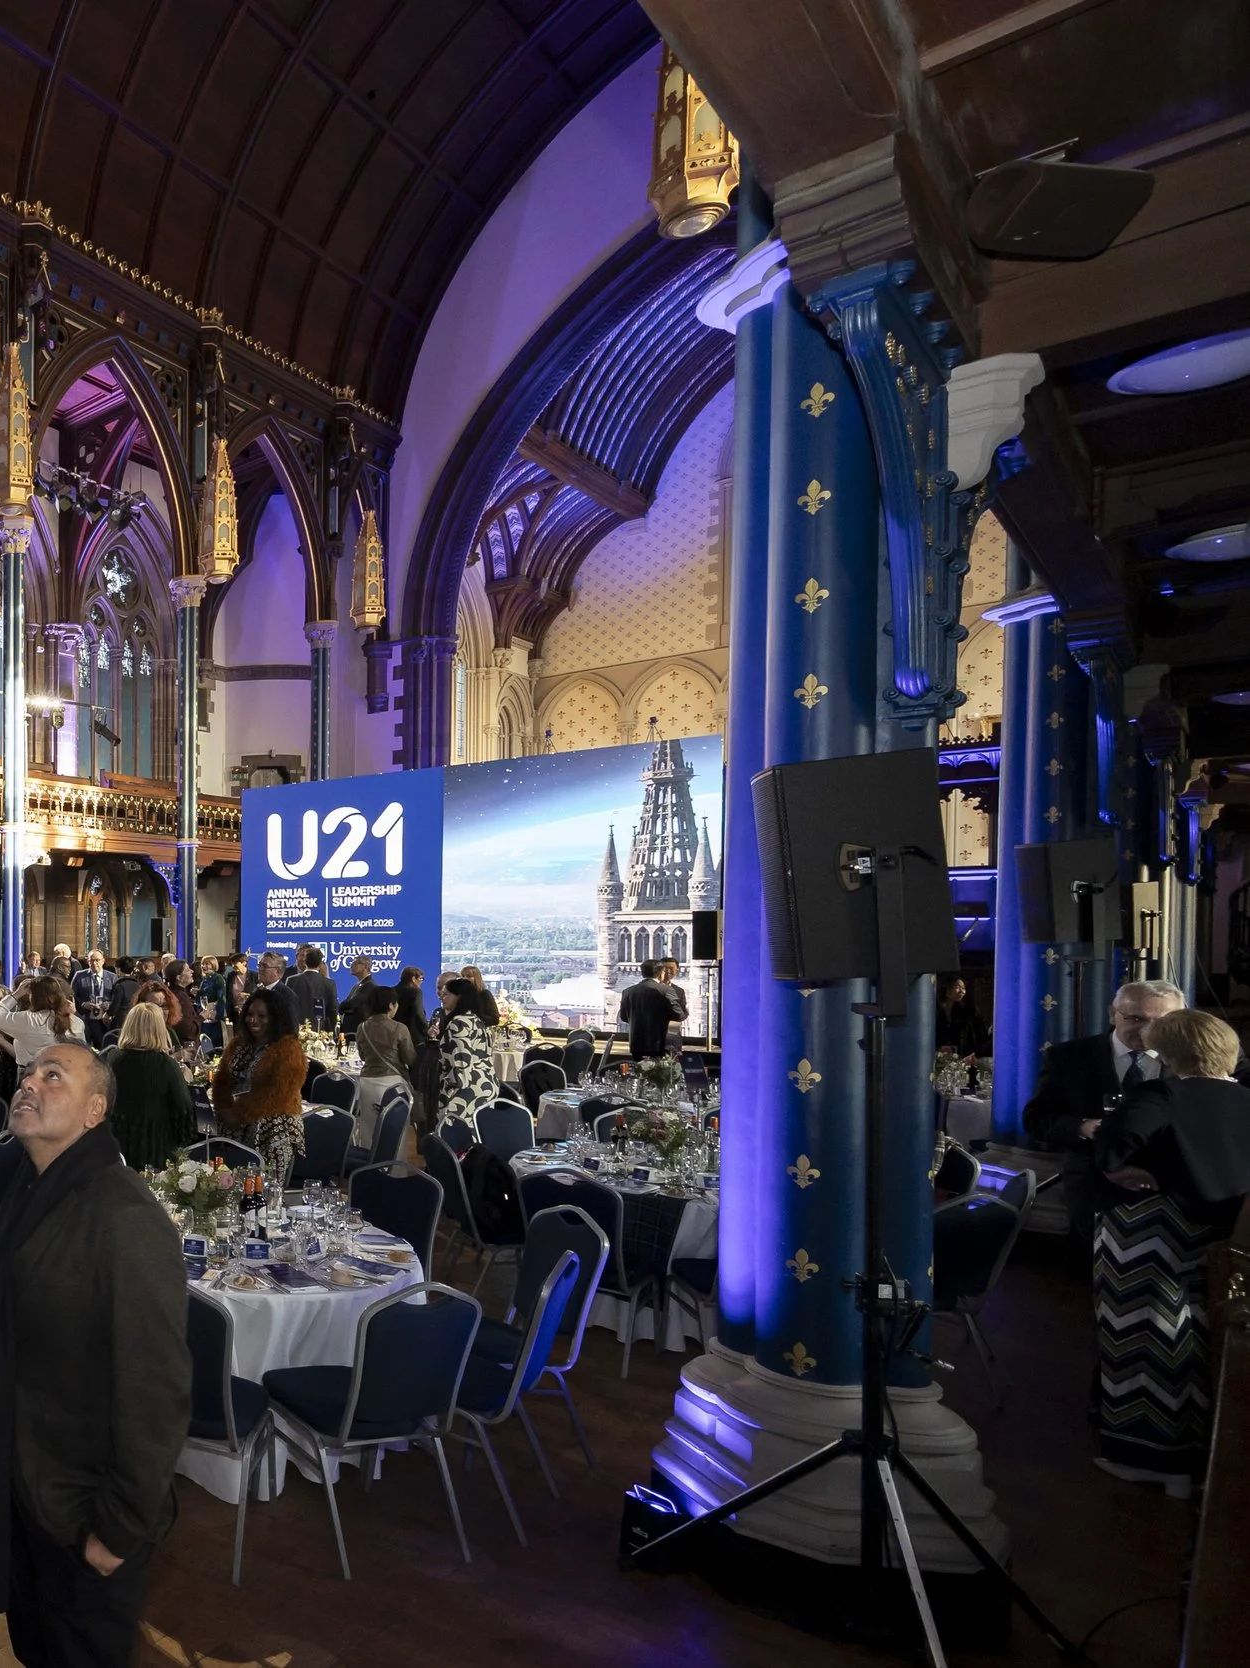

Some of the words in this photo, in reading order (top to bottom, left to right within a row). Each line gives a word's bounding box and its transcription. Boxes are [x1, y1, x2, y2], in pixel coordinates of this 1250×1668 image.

[267, 802, 403, 880] U21
[267, 888, 309, 898] ANNUAL
[332, 884, 402, 896] LEADERSHIP
[267, 898, 317, 908] NETWORK
[332, 896, 377, 907] SUMMIT
[267, 908, 311, 918] MEETING
[266, 920, 287, 928] 20-21
[287, 920, 303, 929] April
[304, 920, 323, 928] 2026
[332, 919, 354, 928] 22-23
[355, 919, 372, 928] April
[374, 919, 394, 927] 2026
[288, 941, 298, 950] by
[330, 941, 401, 959] University
[330, 955, 342, 972] of
[342, 955, 401, 973] Ggow
